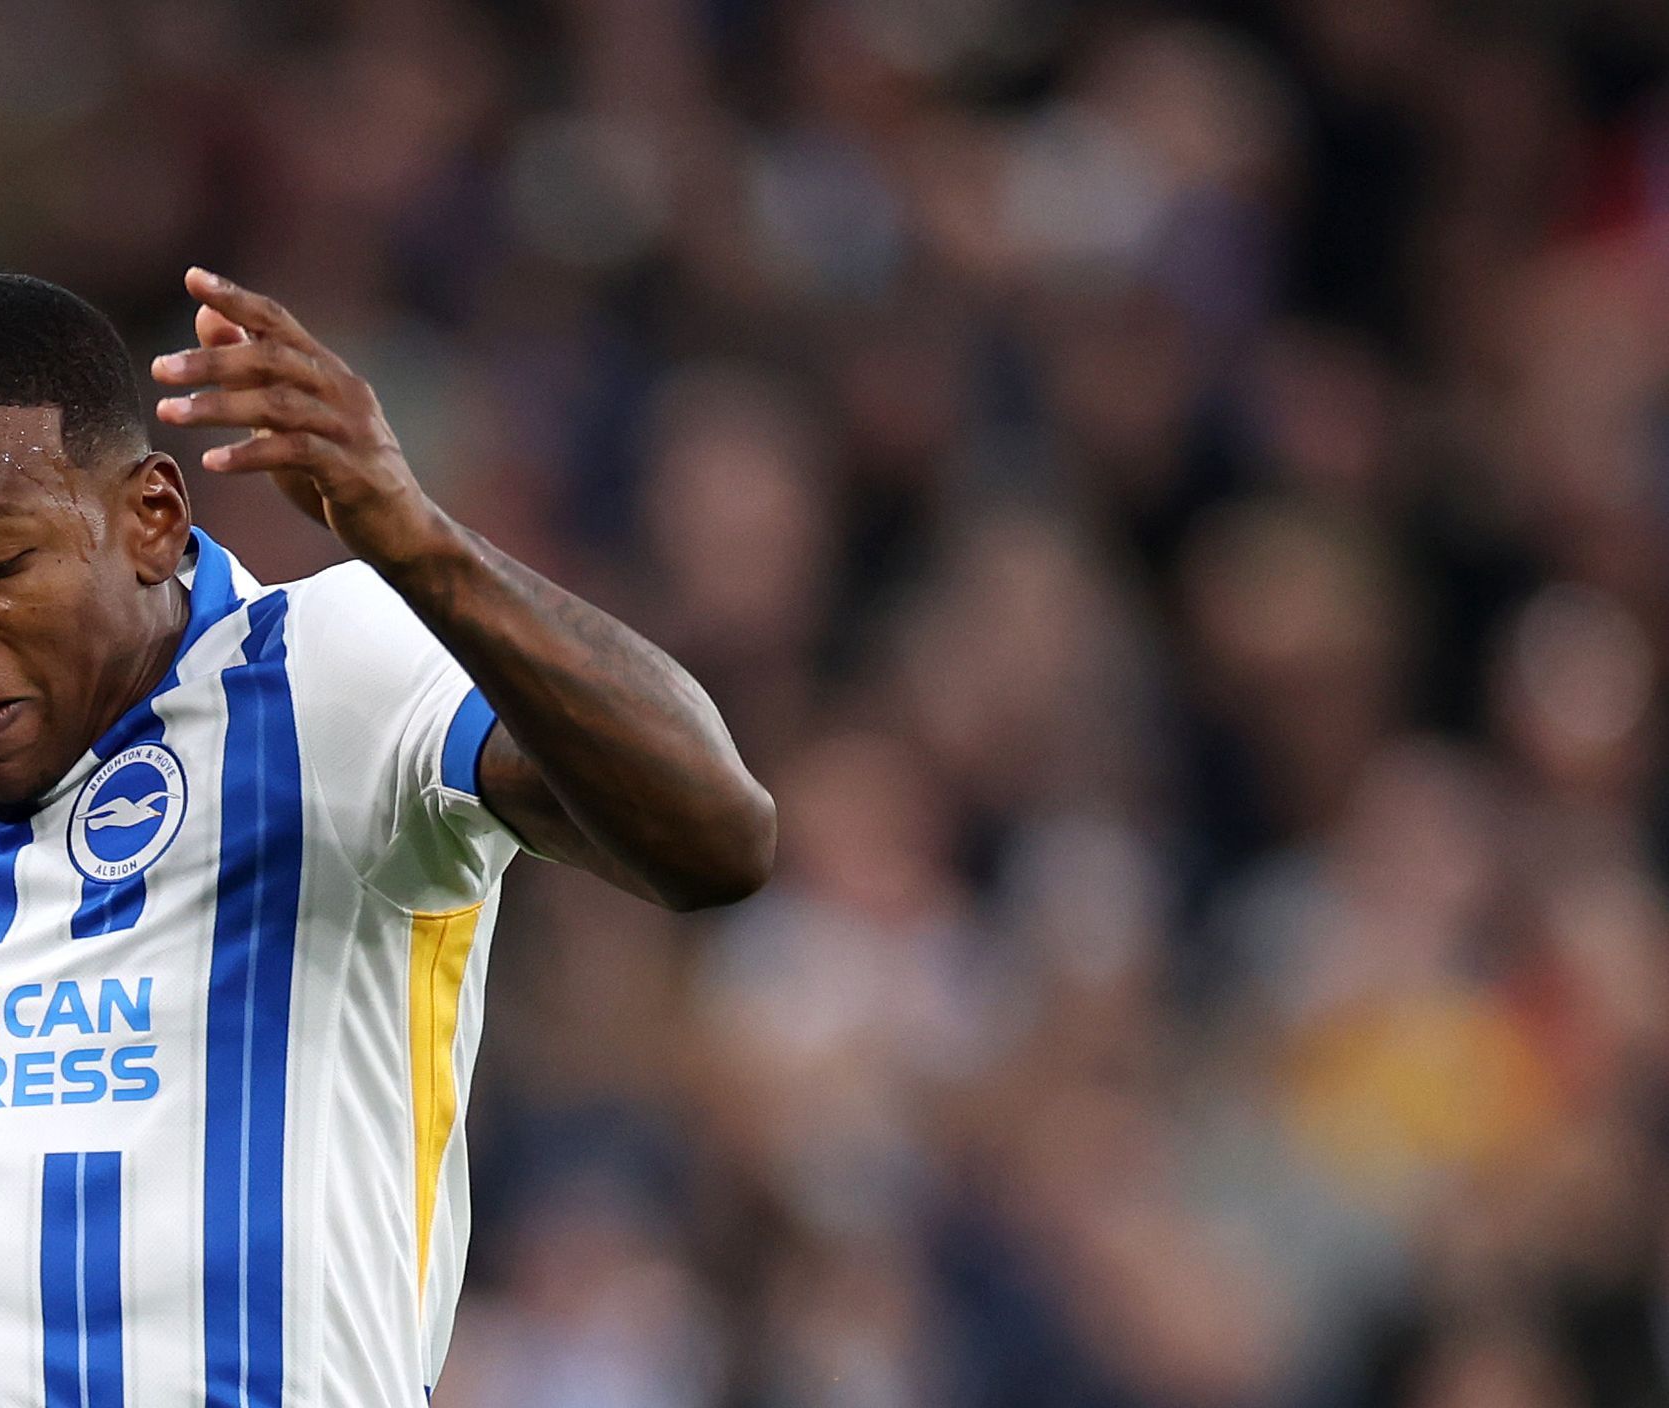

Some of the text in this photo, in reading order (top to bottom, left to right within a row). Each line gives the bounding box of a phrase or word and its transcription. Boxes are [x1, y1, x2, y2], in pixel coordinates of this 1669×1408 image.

[89, 749, 177, 791] BRIGHTON & HOVE
[95, 860, 138, 877] ALBION
